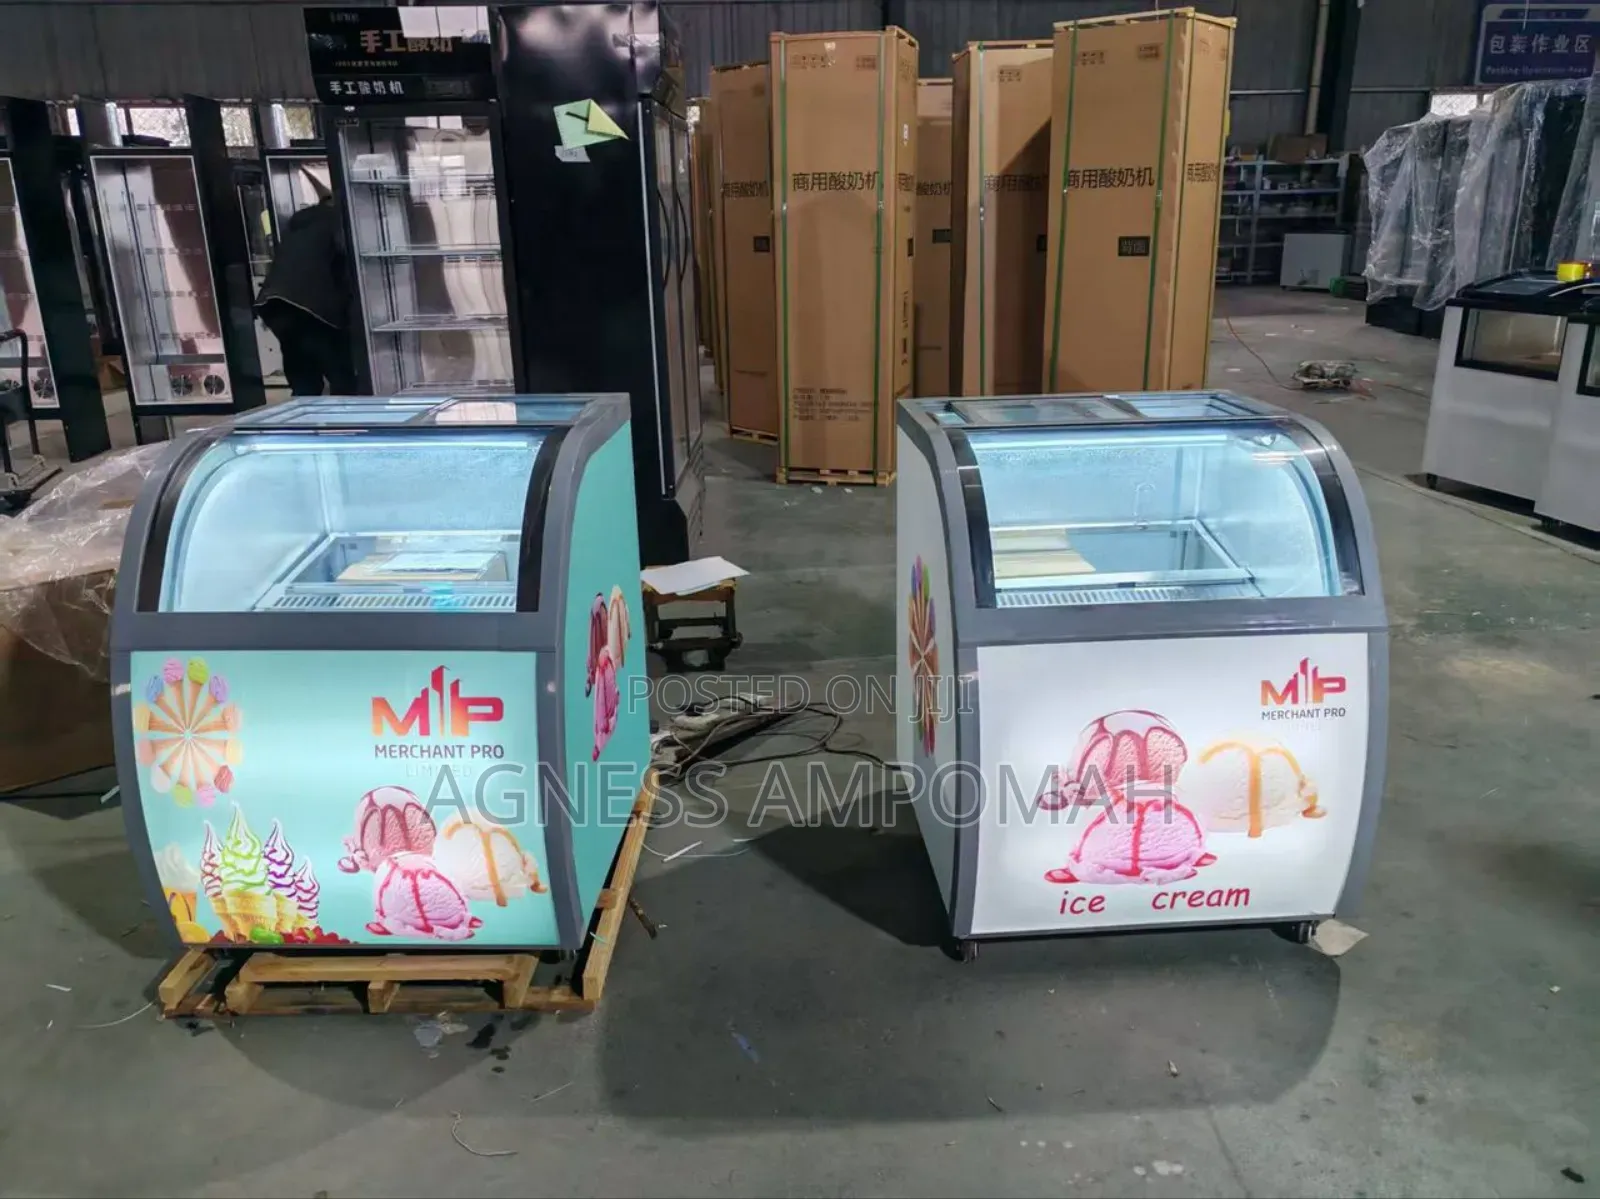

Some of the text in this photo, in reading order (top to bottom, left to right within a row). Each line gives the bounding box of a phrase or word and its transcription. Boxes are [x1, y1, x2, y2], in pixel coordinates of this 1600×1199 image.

[1489, 33, 1593, 55] 包装作业区
[329, 80, 405, 96] 手工酸奶机
[1067, 166, 1155, 189] 商用酸奶机
[1261, 707, 1347, 721] MERCHANT PRO
[374, 743, 505, 760] MERCHANT PRO
[1059, 887, 1251, 915] ice cream
